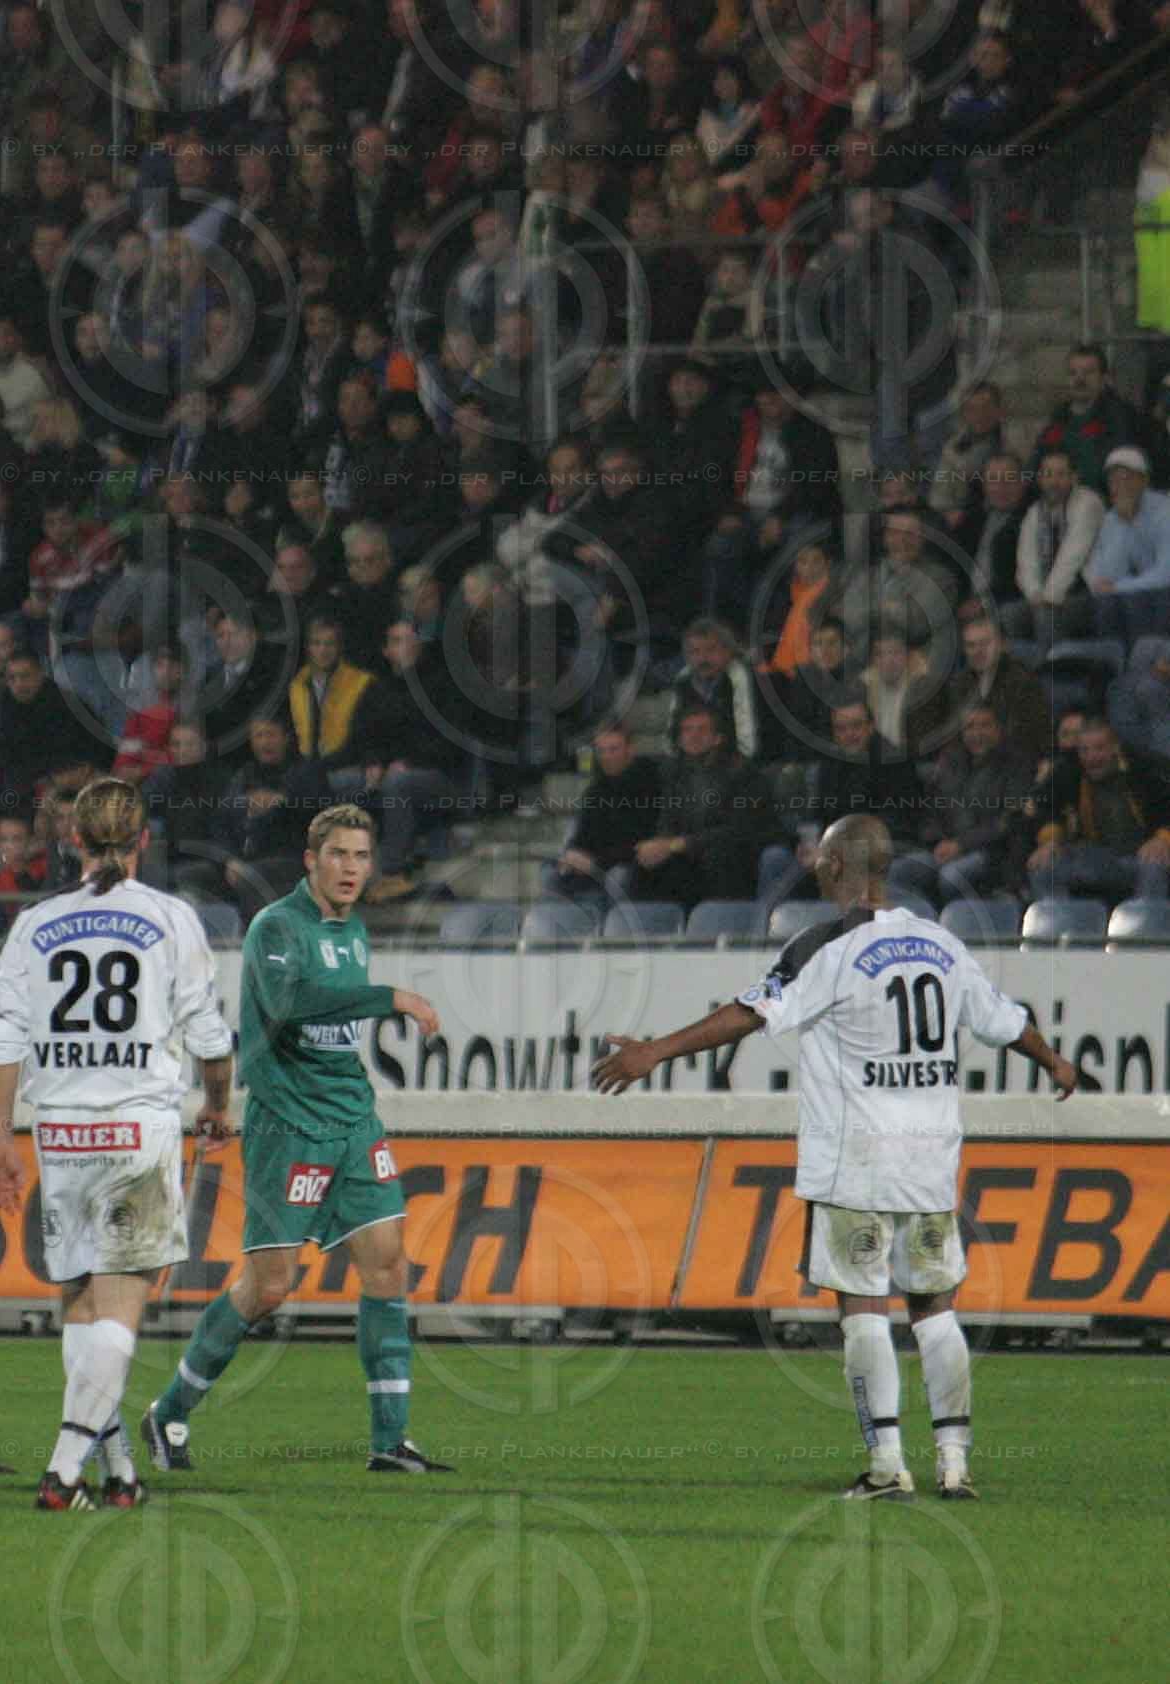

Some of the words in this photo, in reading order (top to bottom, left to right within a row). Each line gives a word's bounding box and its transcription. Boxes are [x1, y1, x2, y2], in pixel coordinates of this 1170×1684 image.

[34, 915, 159, 949] PUNTIGAMER
[48, 950, 140, 1033] 28
[885, 972, 945, 1055] 10
[33, 1041, 153, 1069] VERLAAT
